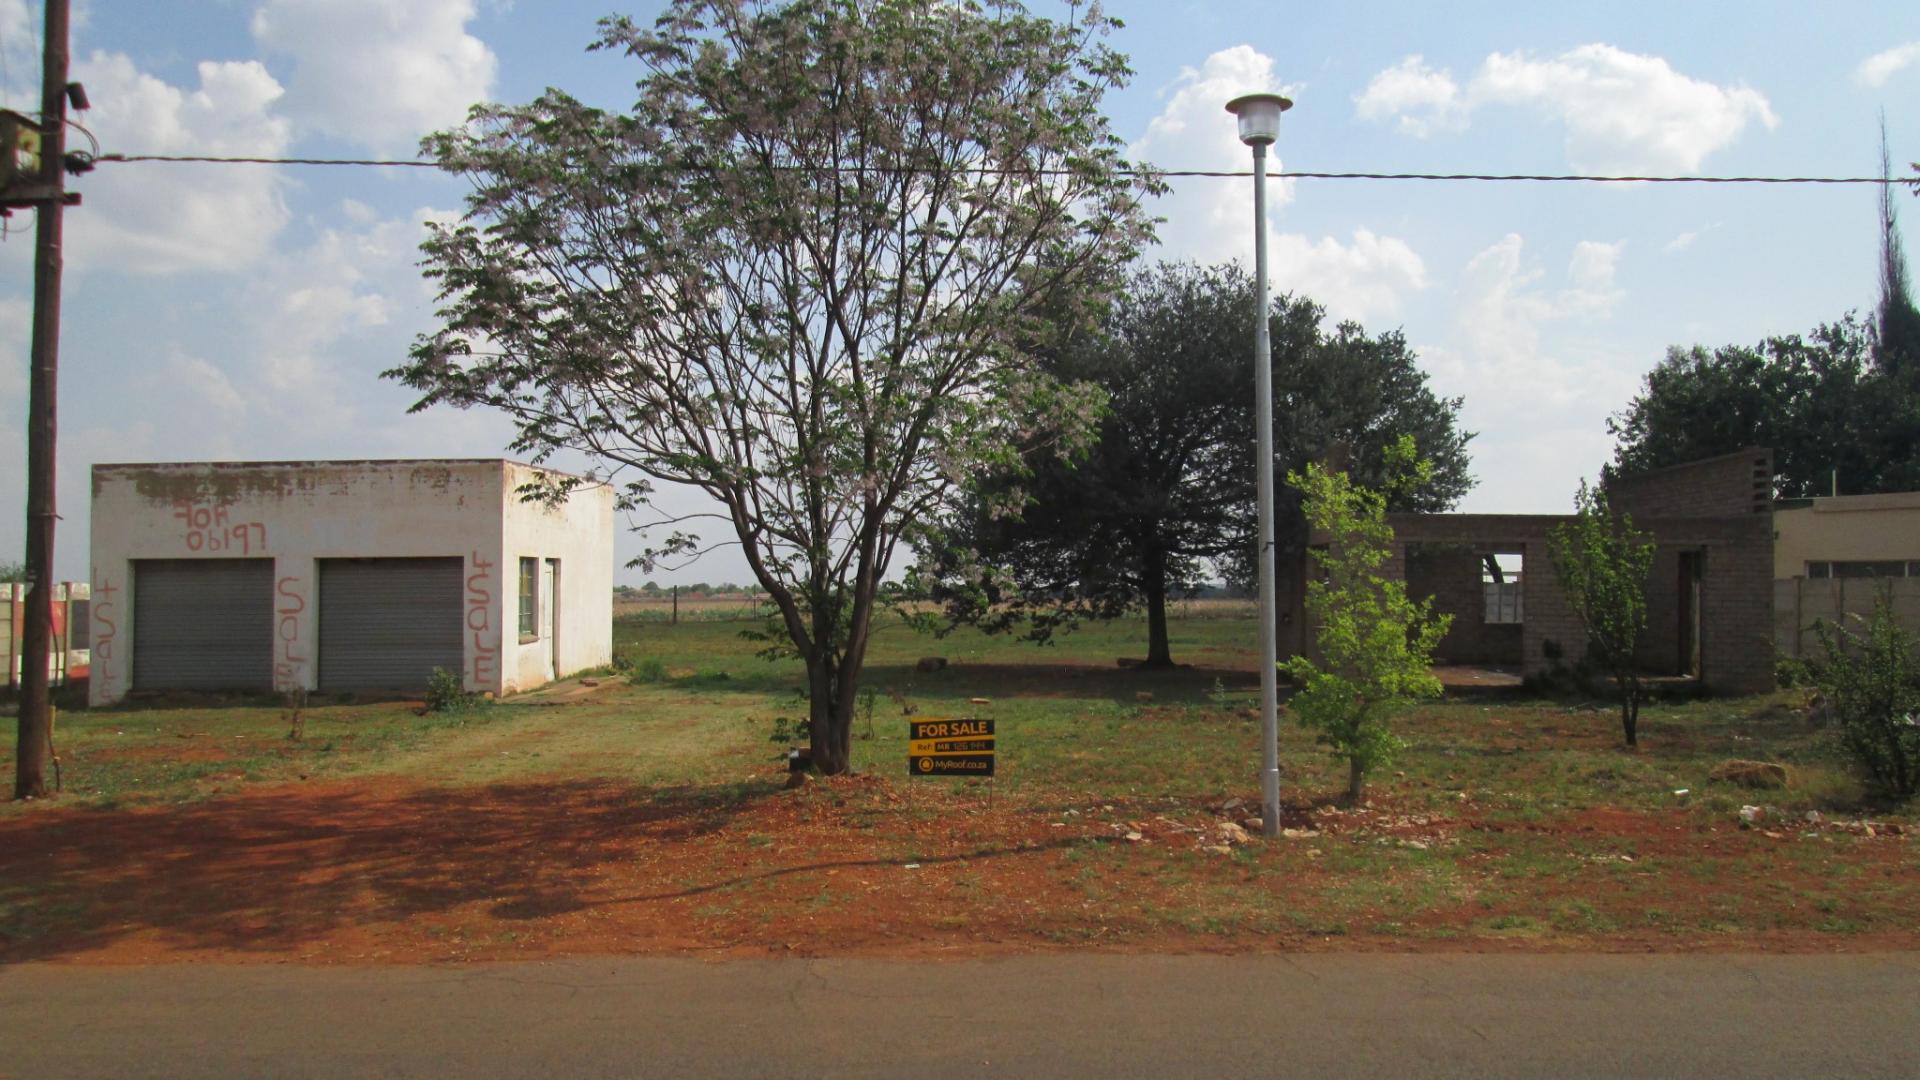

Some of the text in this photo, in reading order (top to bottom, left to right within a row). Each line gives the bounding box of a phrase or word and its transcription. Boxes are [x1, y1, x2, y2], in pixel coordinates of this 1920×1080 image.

[918, 721, 988, 737] FOR SALE
[935, 761, 987, 770] MyRoof.co.za
